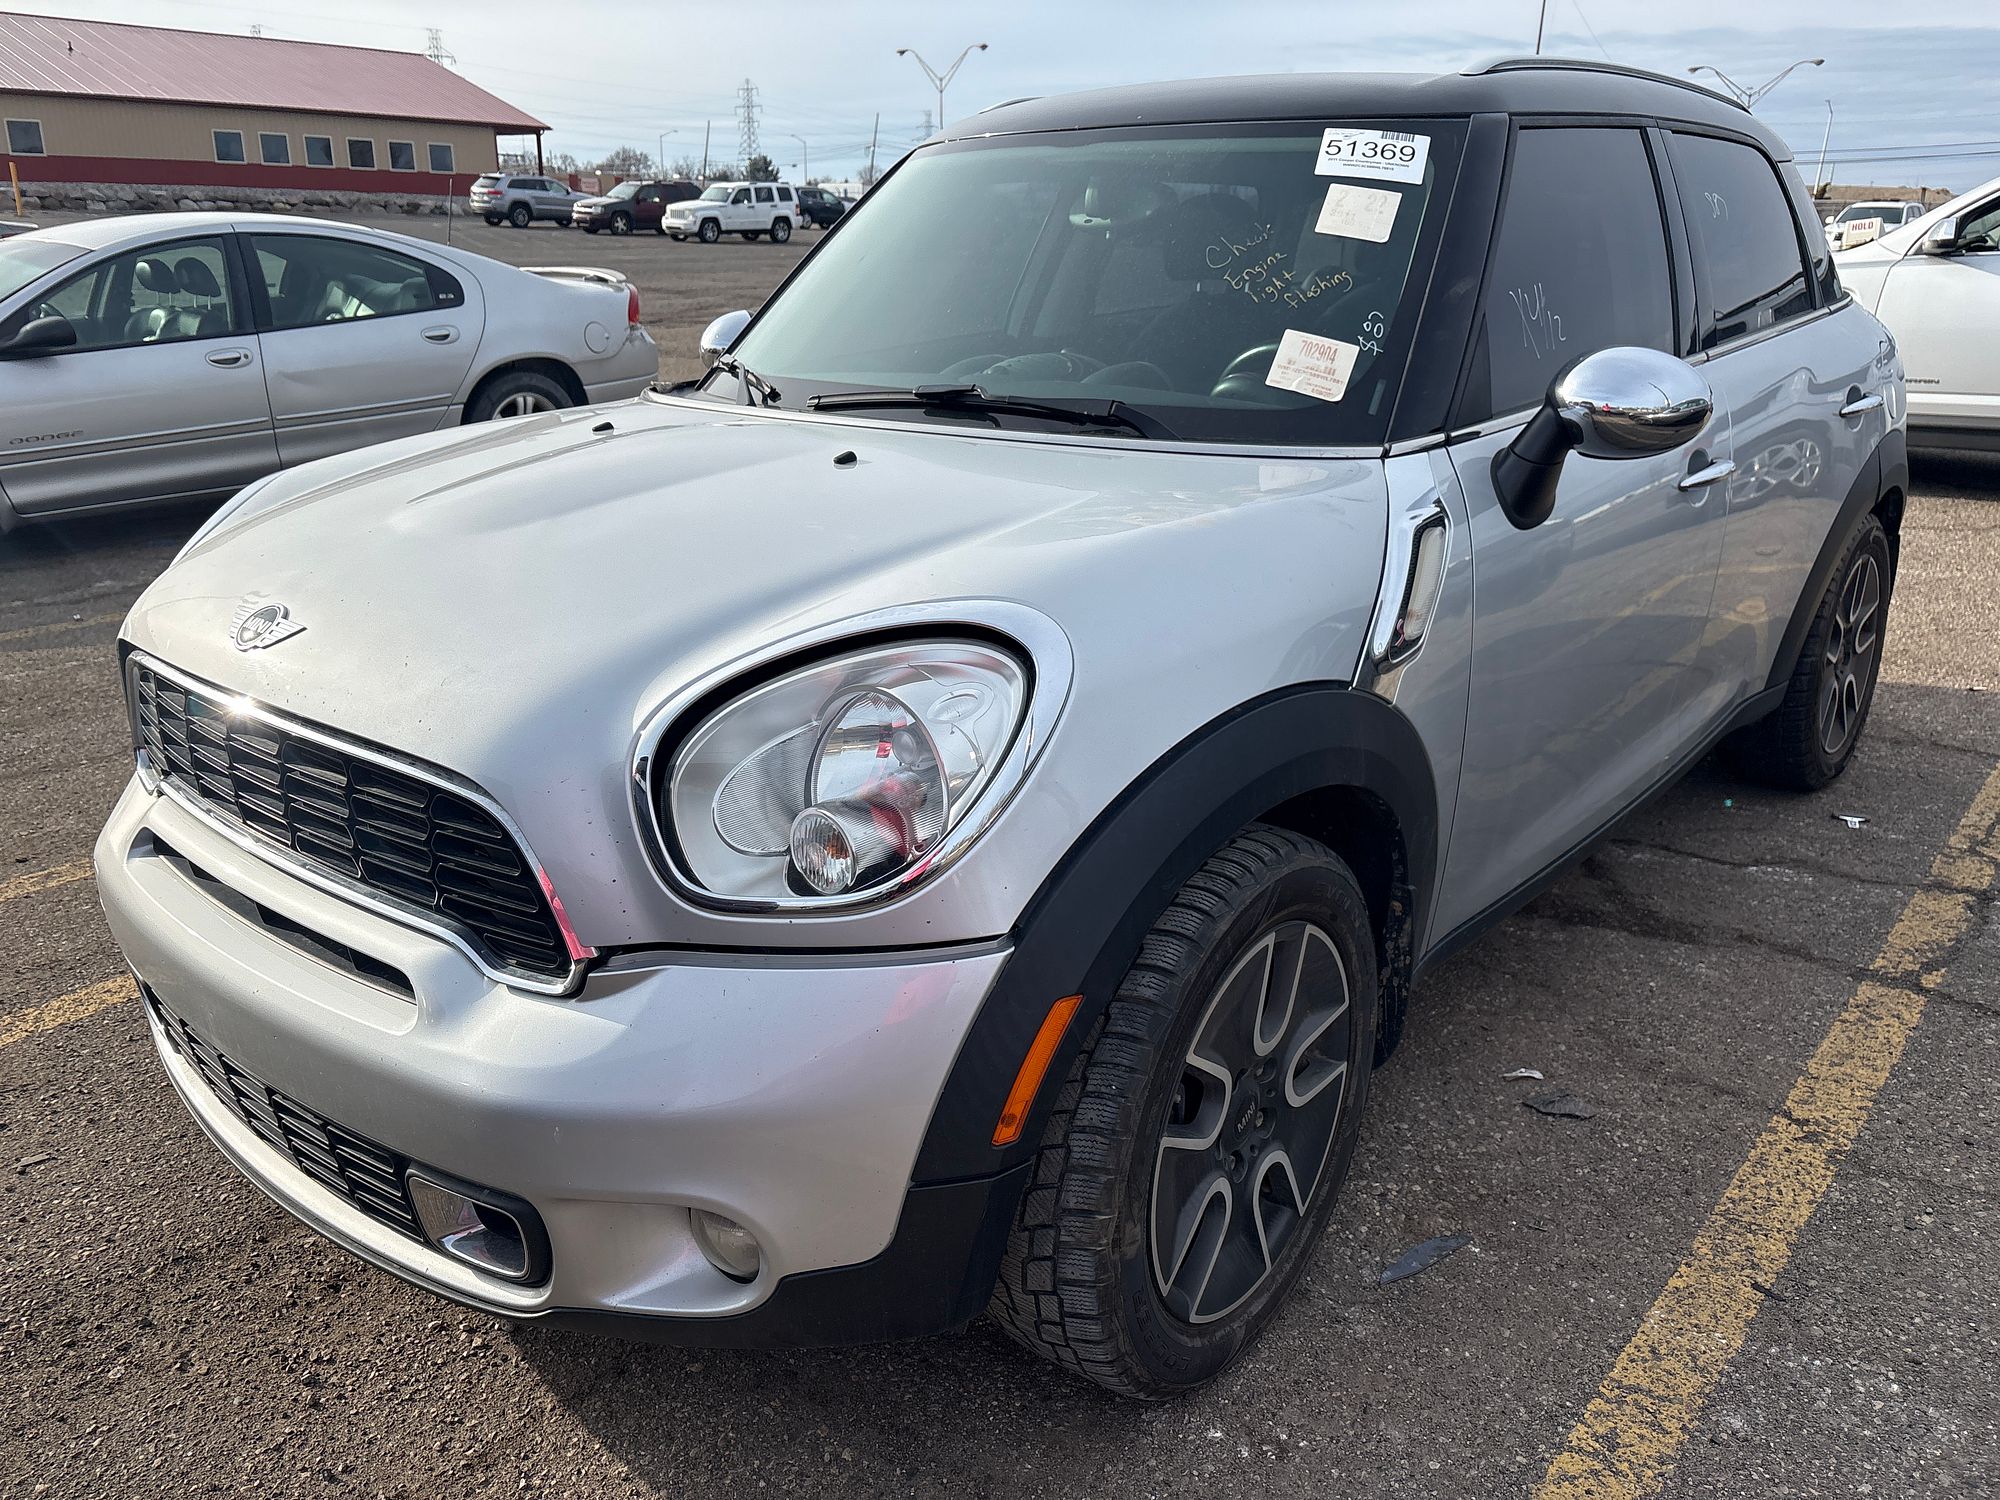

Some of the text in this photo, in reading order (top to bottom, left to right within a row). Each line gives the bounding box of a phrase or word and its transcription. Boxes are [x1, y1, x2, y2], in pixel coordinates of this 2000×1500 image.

[1325, 139, 1416, 163] 51369
[1851, 221, 1874, 232] HOLD
[1223, 252, 1288, 290] Engine
[1283, 270, 1354, 309] flashing
[1299, 340, 1338, 364] 702904
[1237, 1101, 1256, 1133] MINI
